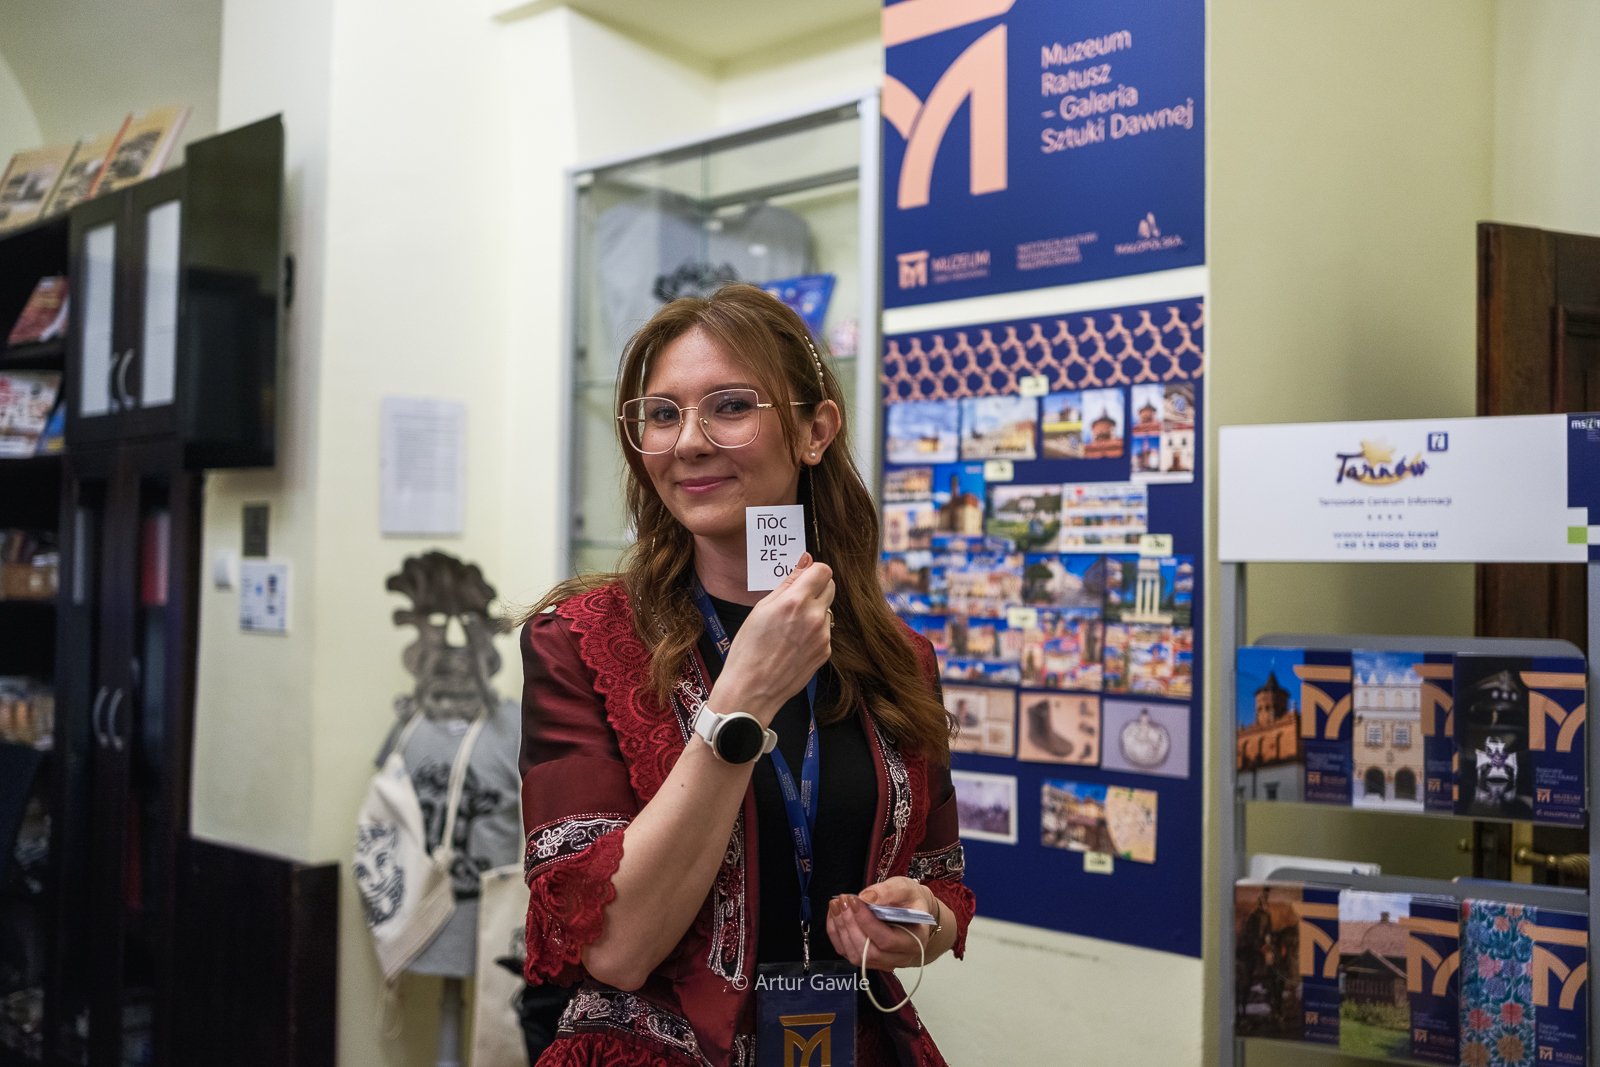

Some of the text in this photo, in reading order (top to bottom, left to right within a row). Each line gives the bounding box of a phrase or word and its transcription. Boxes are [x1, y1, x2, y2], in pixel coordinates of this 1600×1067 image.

[1041, 30, 1132, 68] Muzeum
[1041, 64, 1111, 96] Ratusz
[1059, 84, 1138, 120] Galeria
[1041, 97, 1194, 153] Sztuki Dawnej
[931, 250, 991, 272] MUZEUM
[1336, 453, 1429, 484] Tarnów
